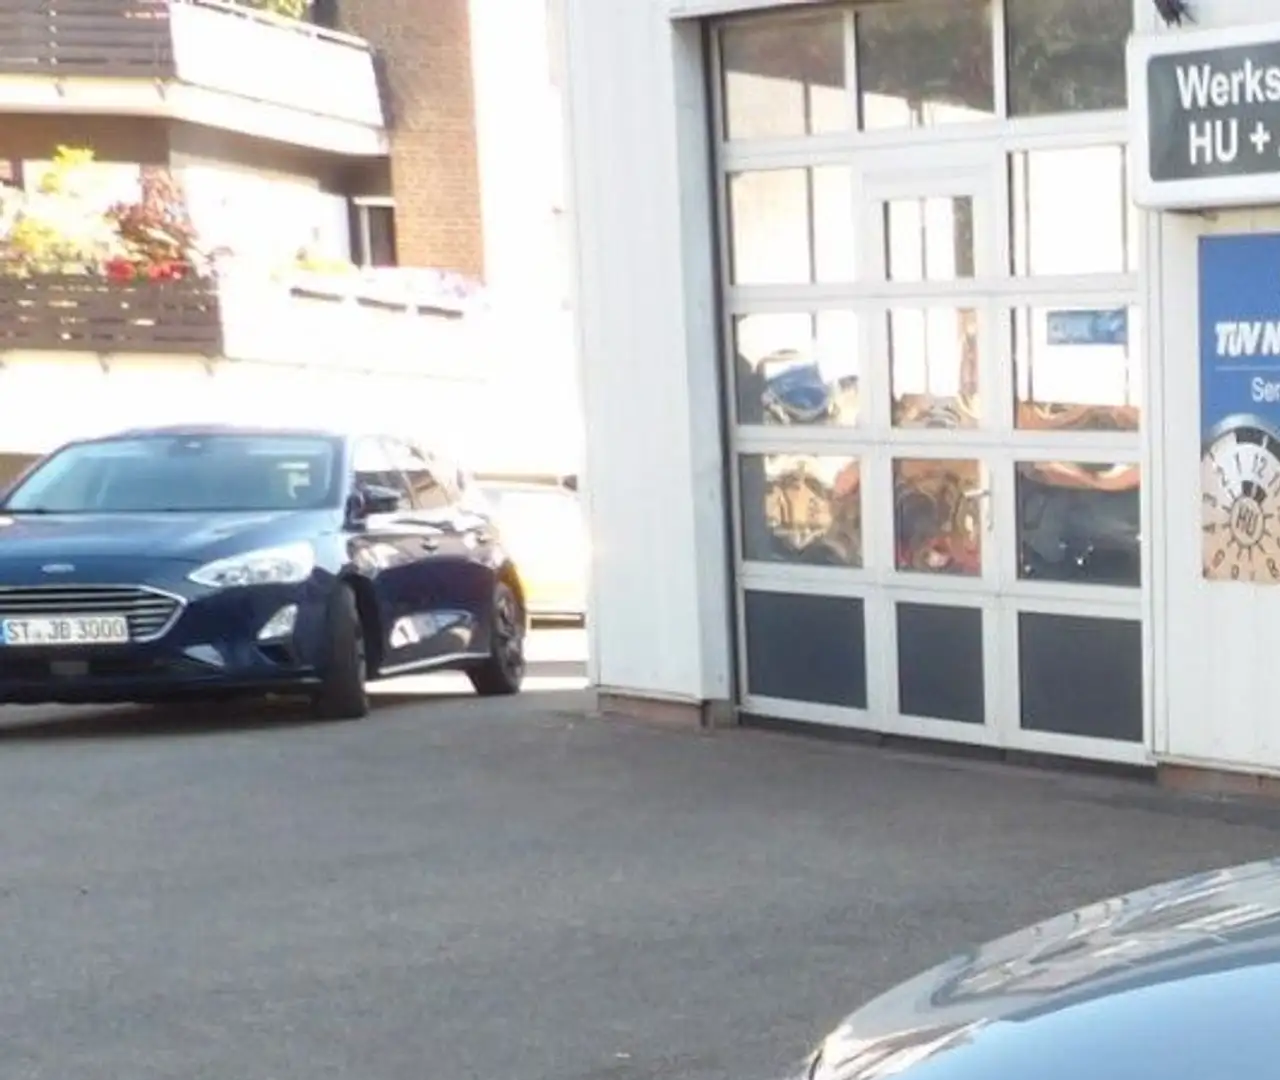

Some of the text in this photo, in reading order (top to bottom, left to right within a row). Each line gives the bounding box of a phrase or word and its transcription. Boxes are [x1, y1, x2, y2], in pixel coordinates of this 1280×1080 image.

[1189, 119, 1238, 165] HU
[1249, 122, 1271, 155] +
[7, 622, 28, 641] ST
[77, 618, 126, 639] 3000
